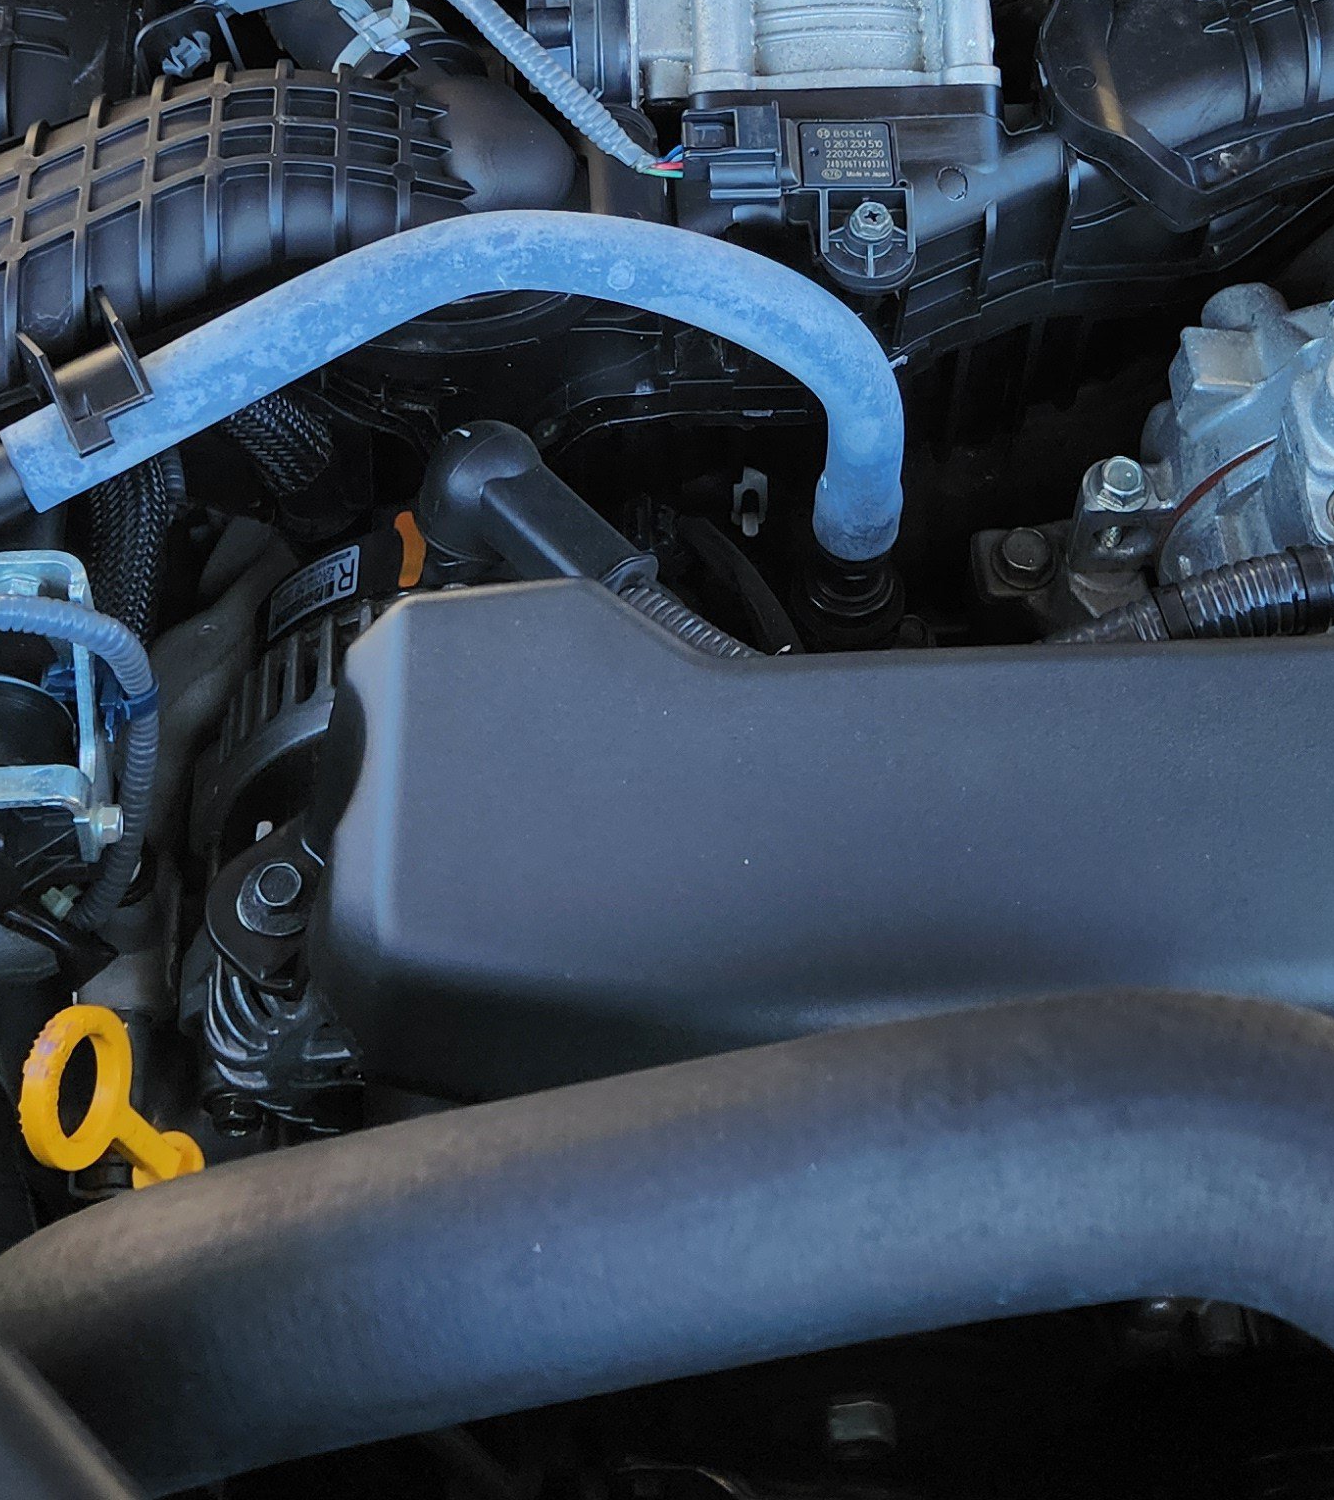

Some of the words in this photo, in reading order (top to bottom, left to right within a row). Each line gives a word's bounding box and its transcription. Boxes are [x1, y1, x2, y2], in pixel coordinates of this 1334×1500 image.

[833, 129, 872, 138] BOSCH
[824, 140, 831, 148] 0
[833, 140, 848, 148] 261
[849, 140, 866, 148] 230
[868, 140, 883, 148] 510
[826, 149, 885, 158] 22012AA250
[338, 558, 356, 592] R
